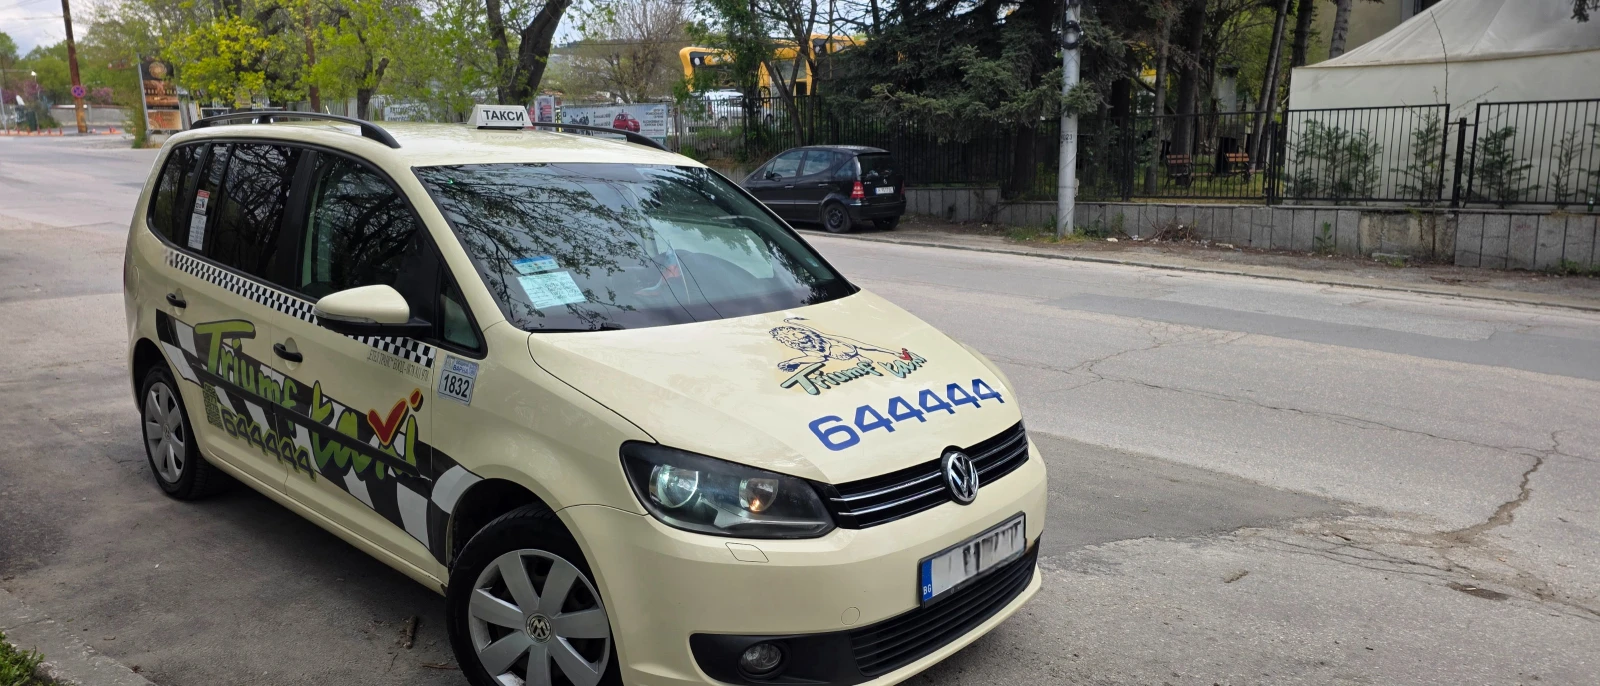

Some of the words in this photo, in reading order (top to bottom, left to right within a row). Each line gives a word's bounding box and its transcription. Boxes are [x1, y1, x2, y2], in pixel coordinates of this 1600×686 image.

[483, 109, 524, 121] ТАКСИ
[194, 319, 298, 438] Triumf
[443, 374, 470, 398] 1832
[780, 361, 884, 396] Triumf
[808, 378, 1005, 451] 644444
[220, 408, 317, 482] 644444
[923, 583, 932, 595] BG
